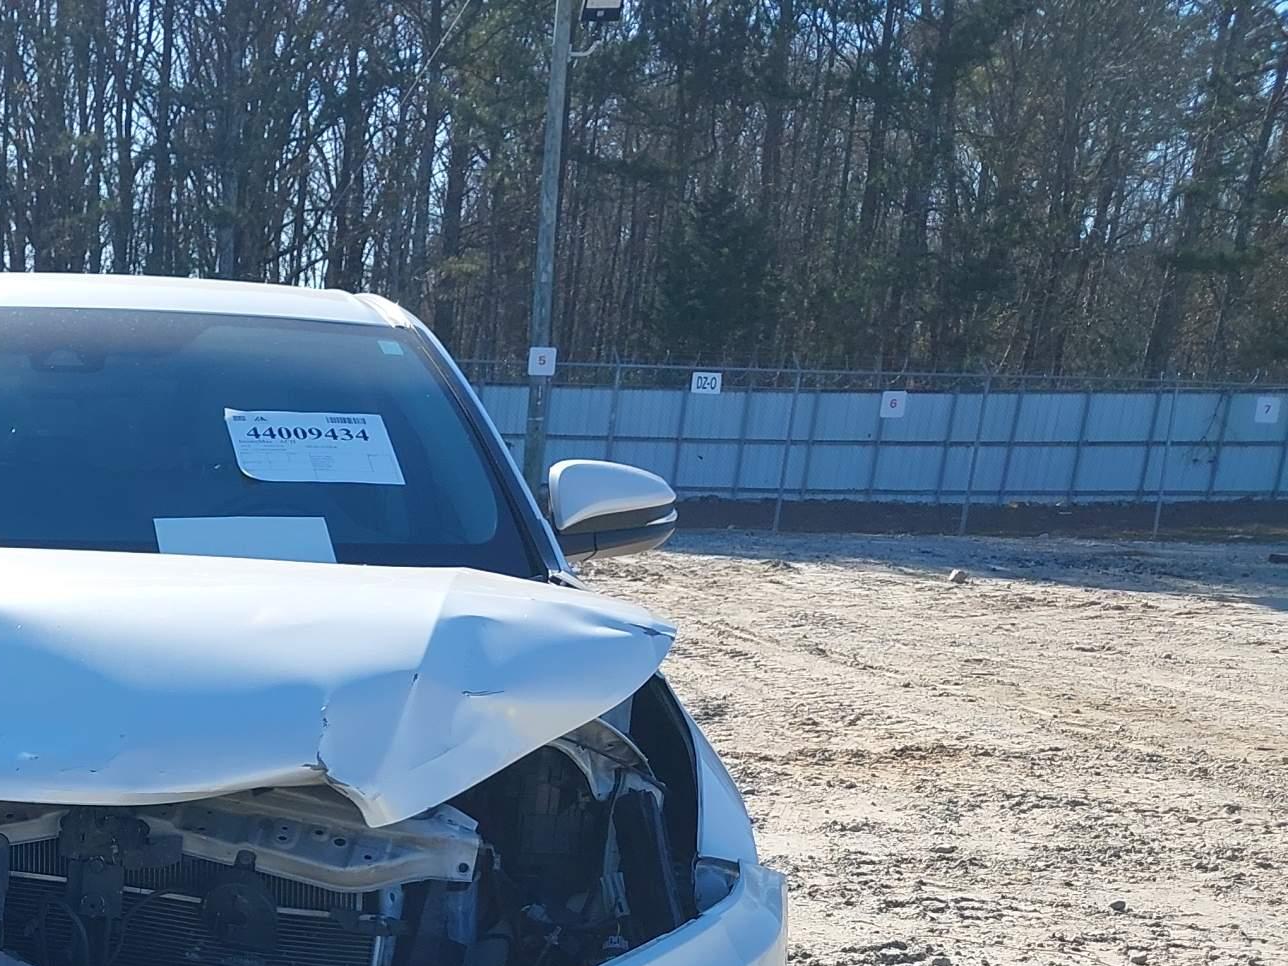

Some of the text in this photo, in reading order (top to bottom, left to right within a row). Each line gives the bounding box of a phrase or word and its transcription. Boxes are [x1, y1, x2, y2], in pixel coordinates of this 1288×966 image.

[538, 355, 546, 366] 5
[889, 398, 898, 409] 6
[1264, 404, 1272, 414] 7
[246, 426, 370, 442] 44009434
